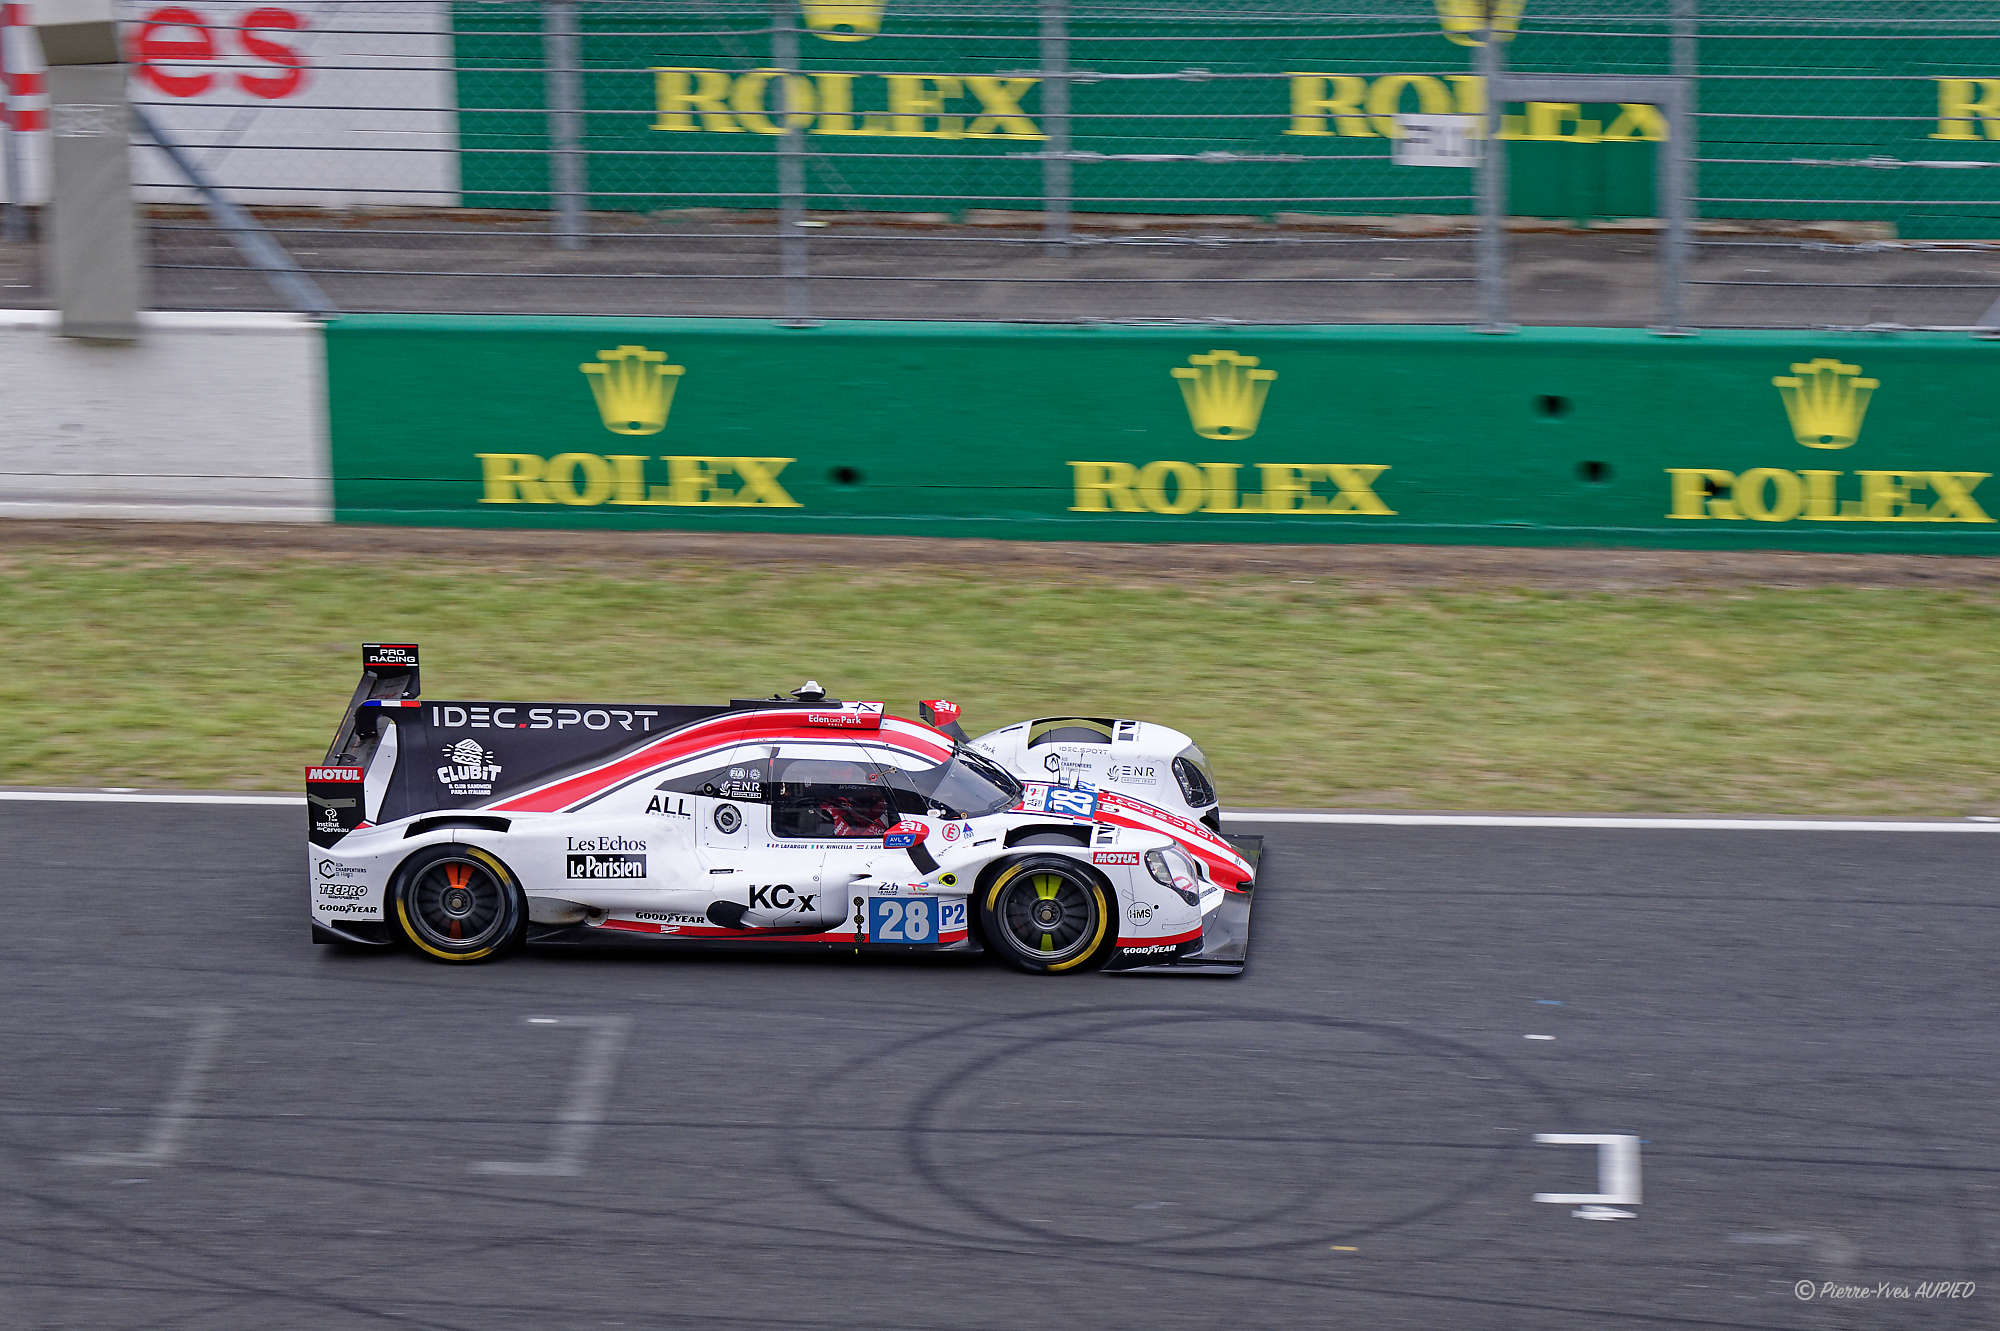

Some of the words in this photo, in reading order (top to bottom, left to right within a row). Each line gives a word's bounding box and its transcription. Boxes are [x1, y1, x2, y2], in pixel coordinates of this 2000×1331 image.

[649, 67, 1050, 141] ROLEX
[475, 452, 804, 508] ROLEX
[1067, 460, 1398, 516] ROLEX
[1665, 467, 1996, 523] ROLEX
[369, 655, 416, 663] RACING
[808, 713, 829, 723] Eden
[841, 715, 862, 724] Park
[308, 768, 360, 781] MOTUL
[645, 794, 691, 817] ALL
[1048, 788, 1094, 816] 28
[567, 836, 595, 851] Les
[598, 835, 647, 851] Echos
[570, 860, 585, 878] Le
[585, 855, 643, 878] Parisien
[1094, 853, 1138, 864] MOTUL
[320, 884, 368, 897] TECPRO
[749, 884, 816, 912] KCx
[879, 901, 930, 941] 28
[942, 904, 965, 925] P2
